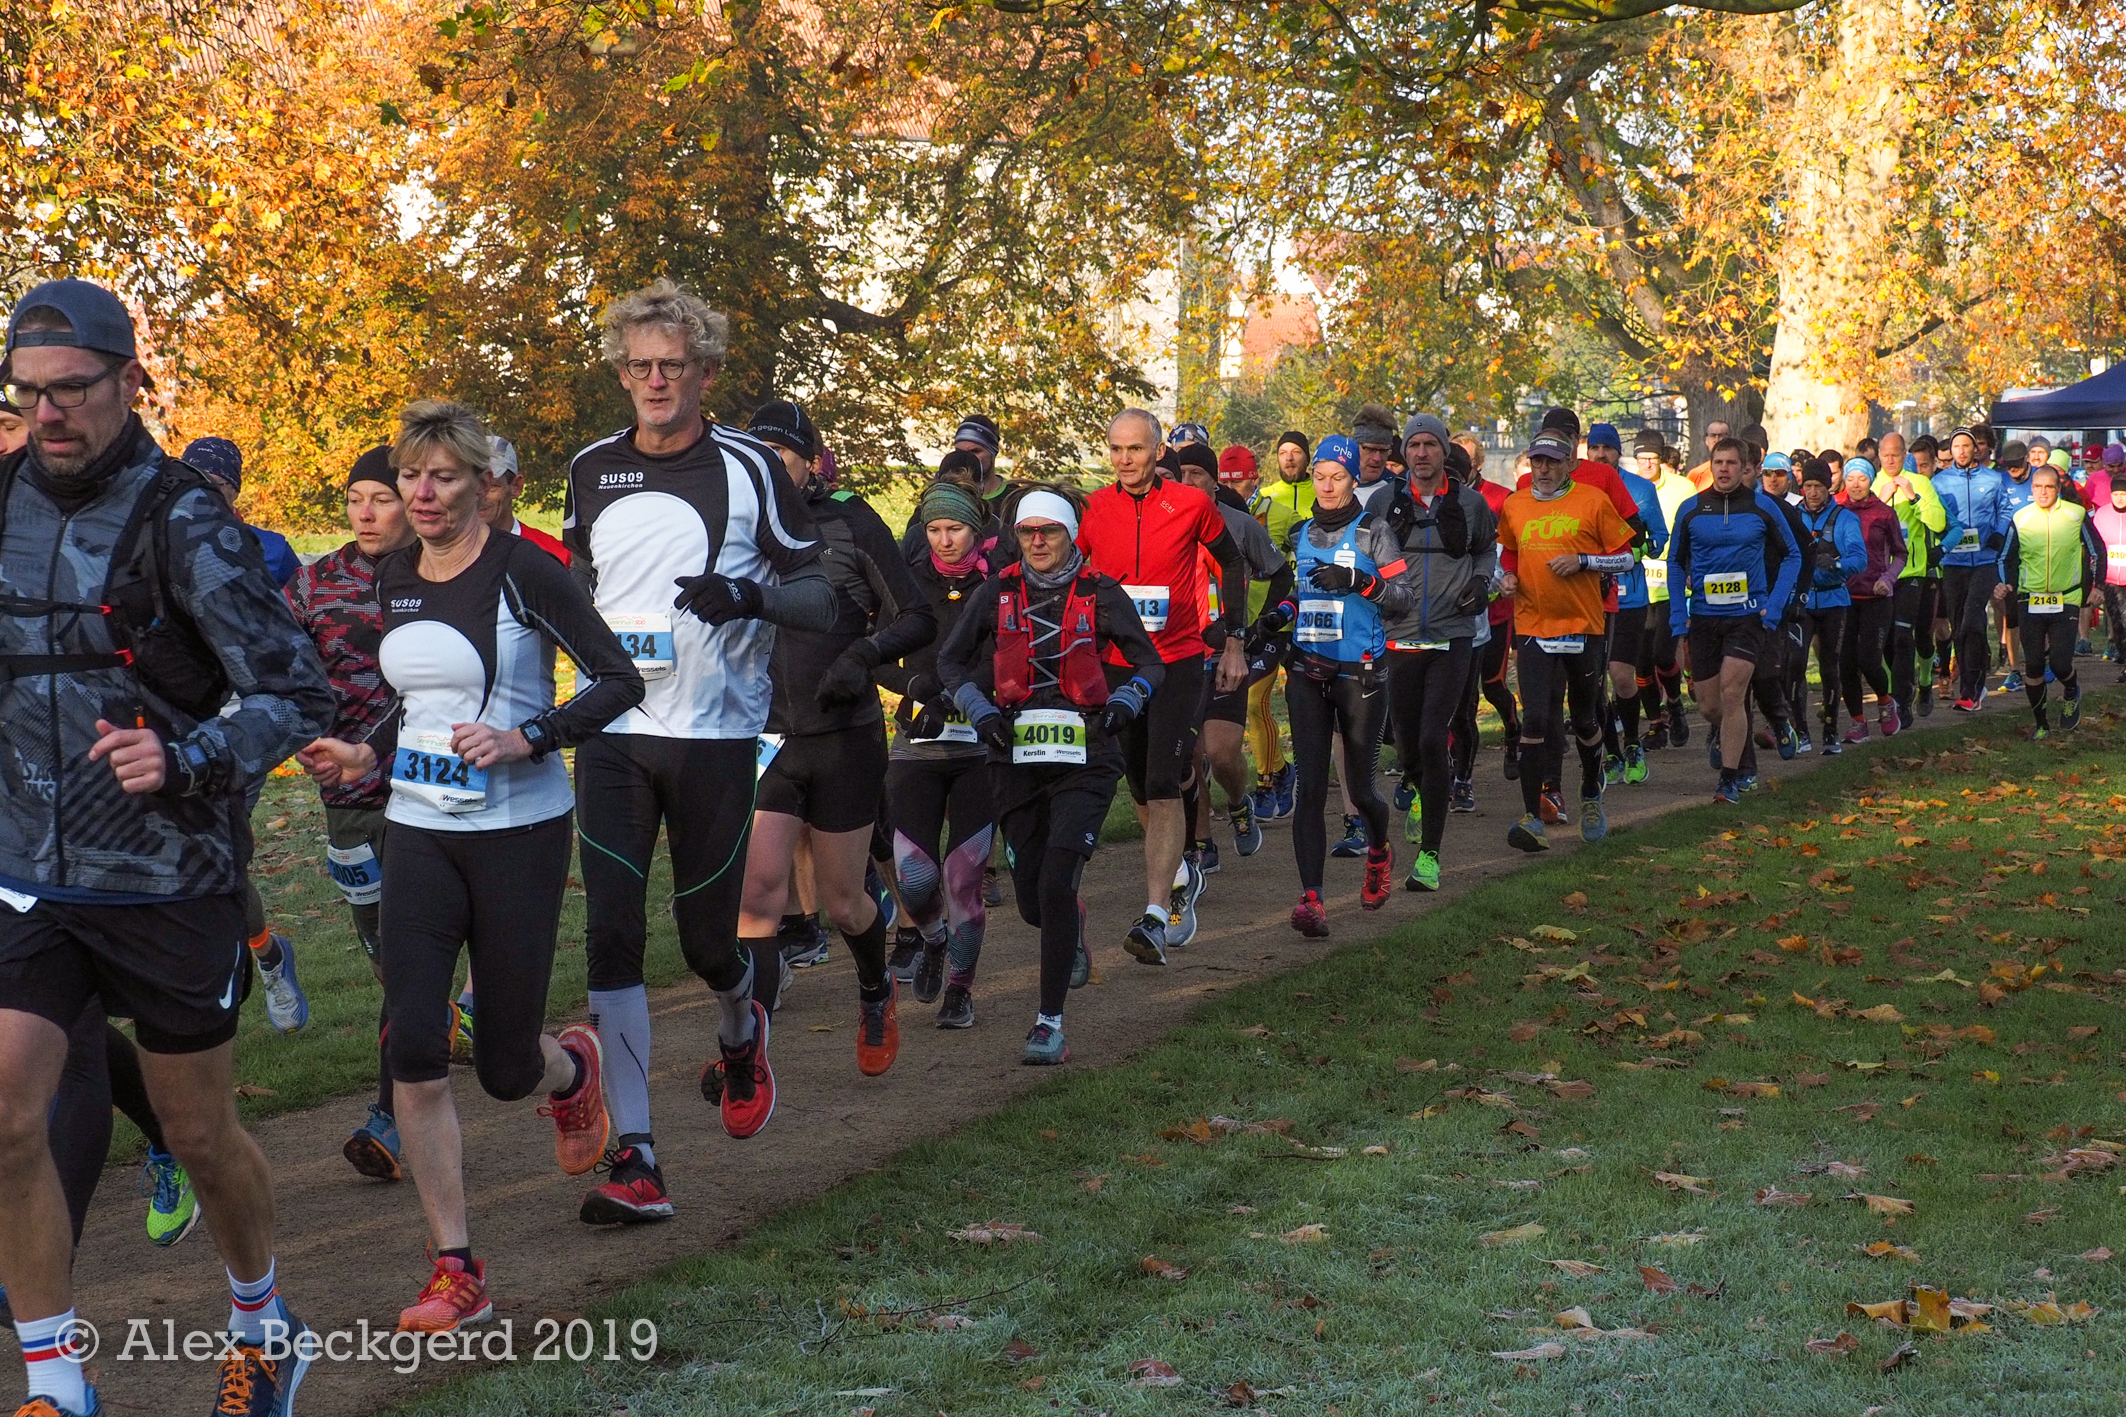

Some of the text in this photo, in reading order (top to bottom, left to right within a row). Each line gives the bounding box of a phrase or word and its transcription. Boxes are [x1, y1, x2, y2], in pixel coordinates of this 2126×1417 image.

[757, 424, 783, 433] gegen
[784, 429, 805, 446] Leiden
[1333, 444, 1352, 459] DNB
[599, 471, 644, 485] SUS09
[1161, 500, 1176, 513] GORE
[1521, 516, 1580, 541] PUM
[1711, 582, 1741, 594] 2128
[391, 598, 422, 608] SUS09
[2034, 596, 2058, 605] 2149
[1301, 612, 1333, 628] 3066
[1023, 725, 1075, 745] 4019
[1023, 749, 1046, 757] Kerstin
[404, 752, 470, 787] 3124
